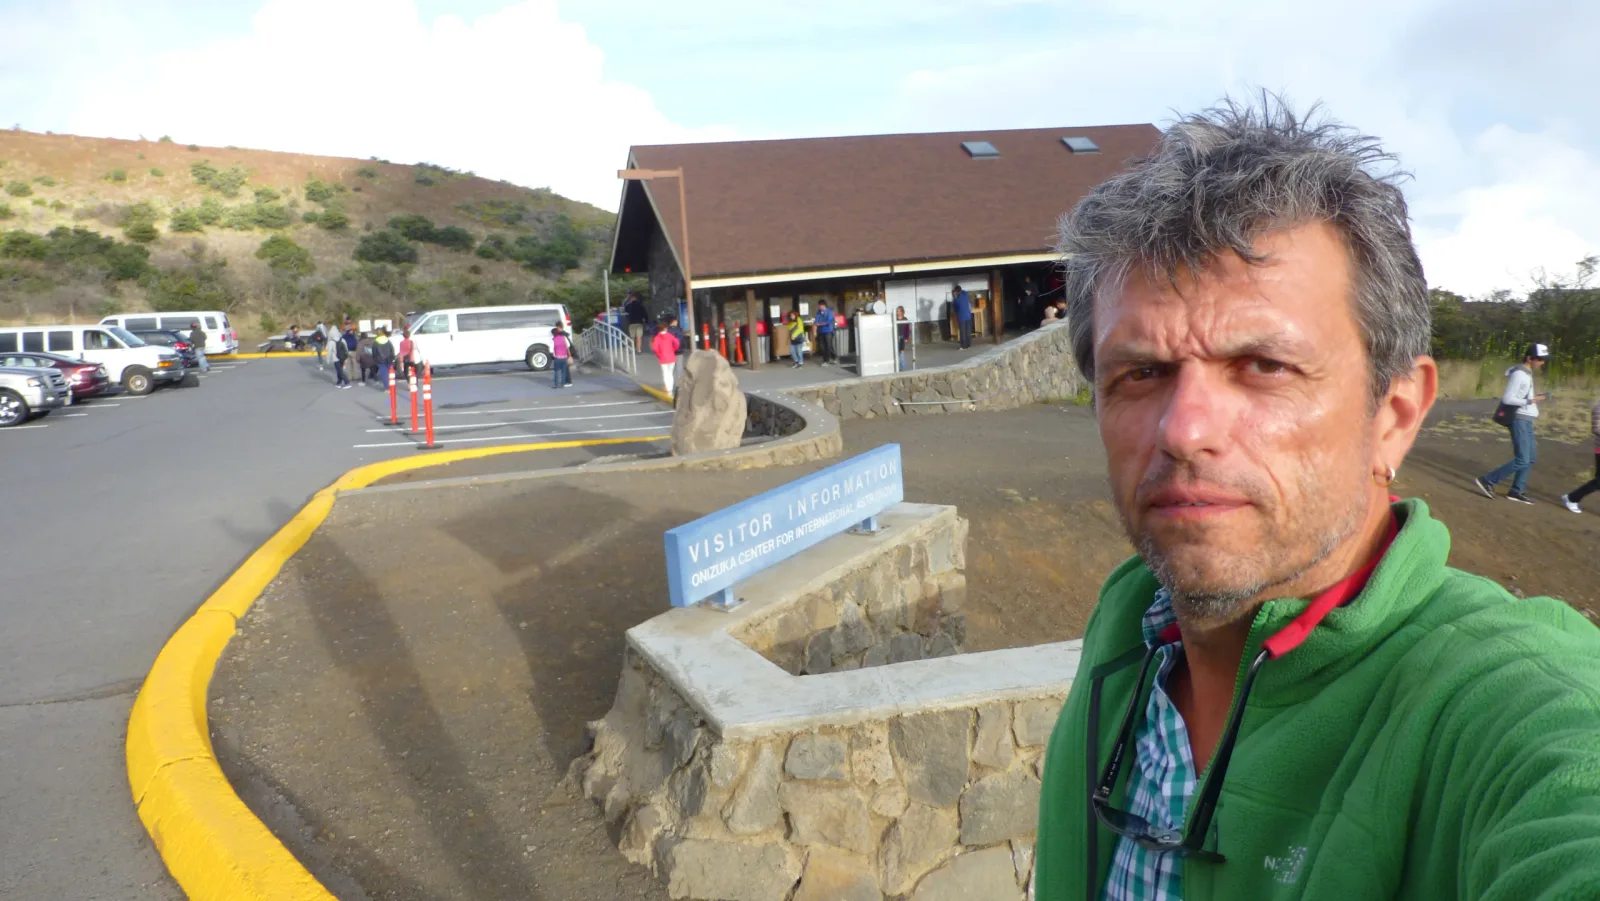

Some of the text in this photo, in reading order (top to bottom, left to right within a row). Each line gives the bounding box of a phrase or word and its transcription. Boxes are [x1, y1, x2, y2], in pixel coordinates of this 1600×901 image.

[689, 460, 897, 562] VISITOR INFORMATION
[692, 483, 897, 587] ONIZUKA CENTER FOR INTERNATIONAL ASTROMY
